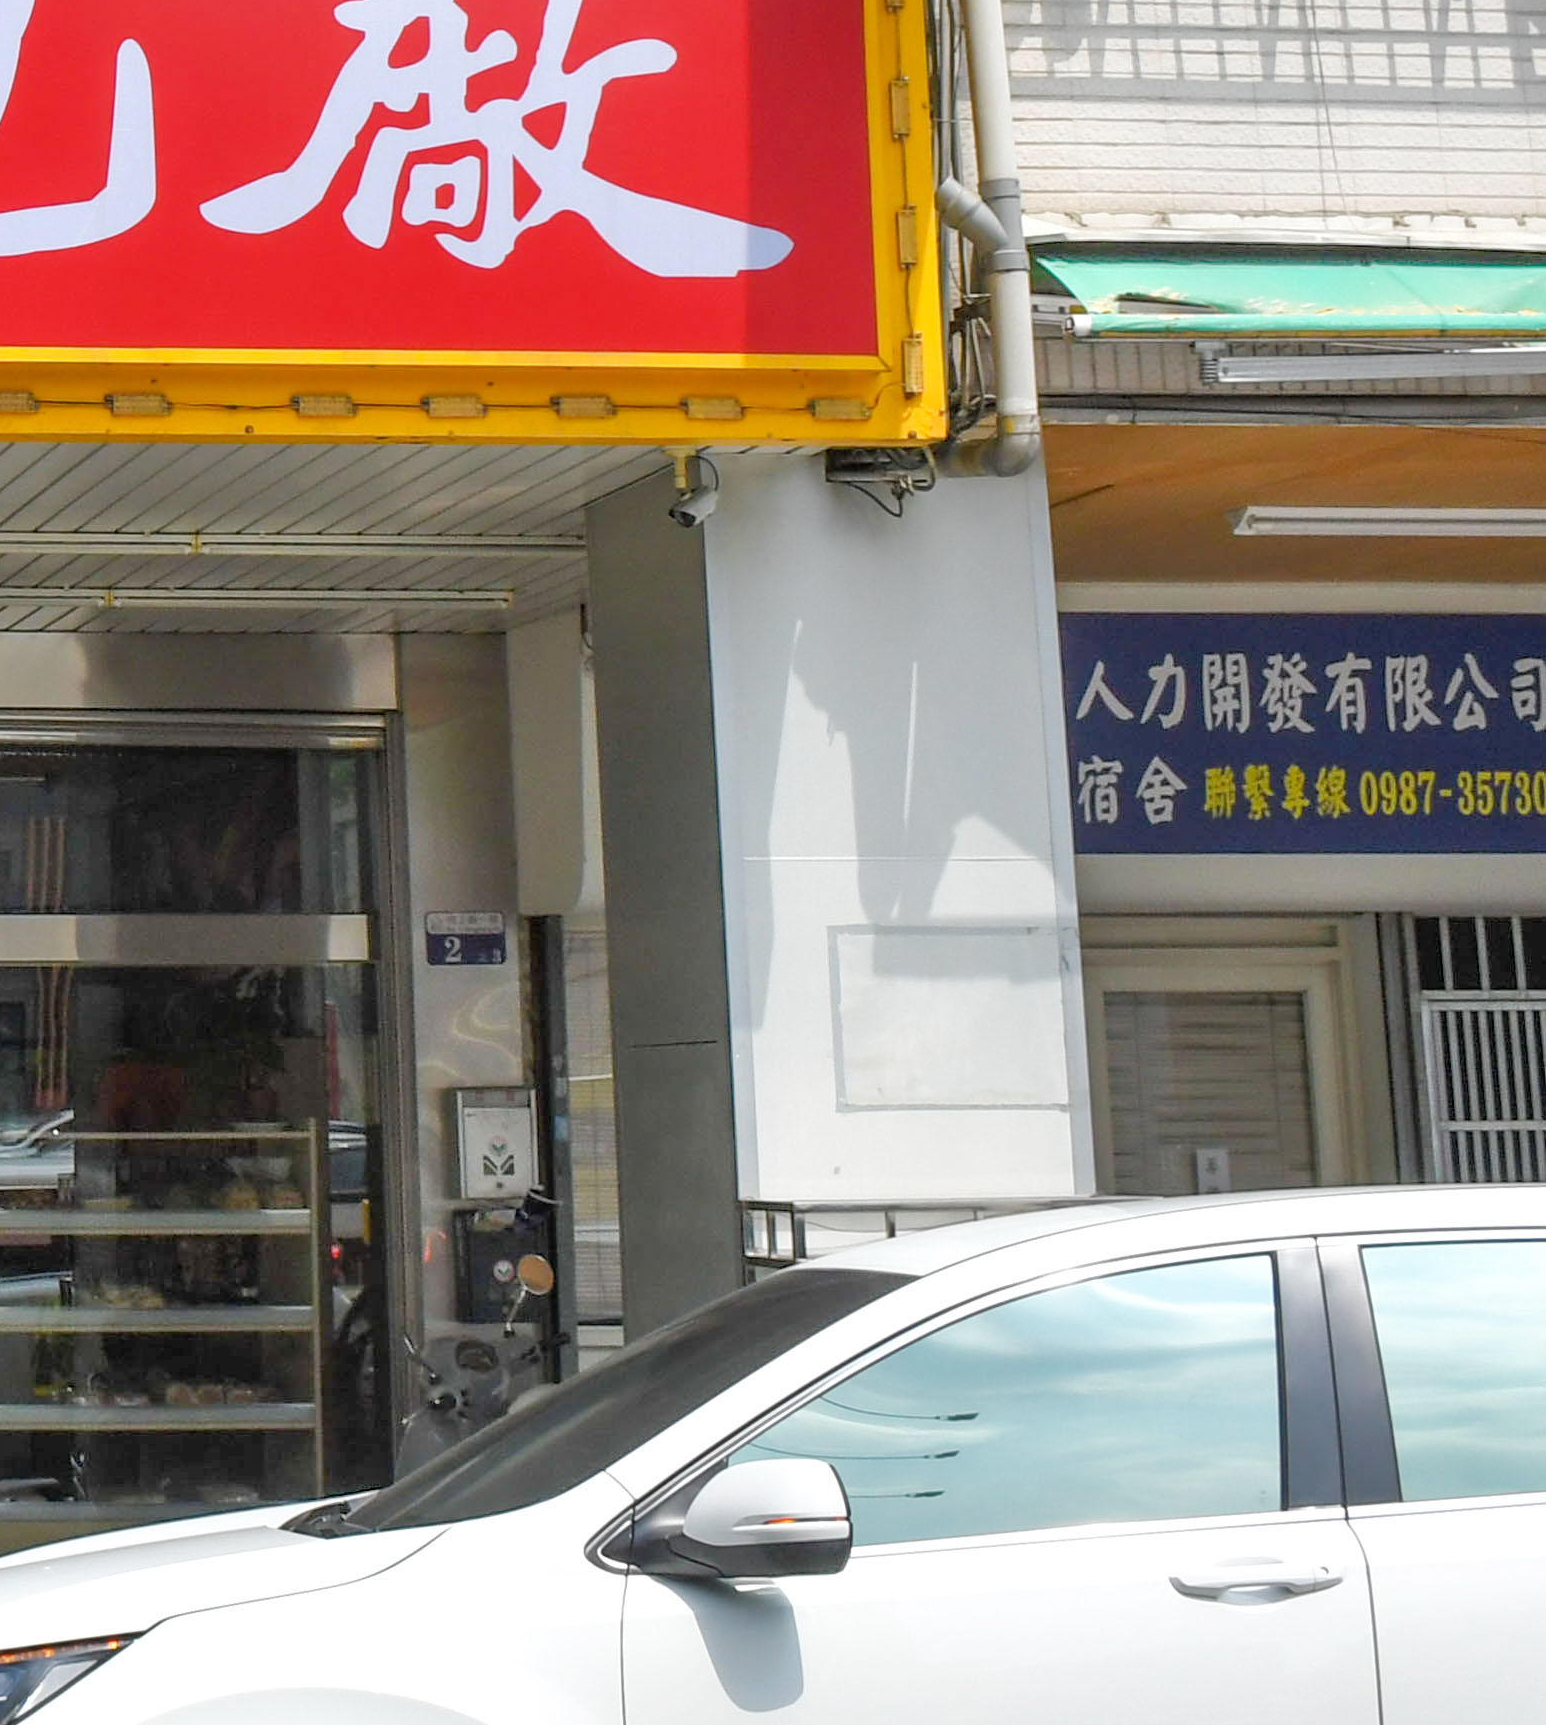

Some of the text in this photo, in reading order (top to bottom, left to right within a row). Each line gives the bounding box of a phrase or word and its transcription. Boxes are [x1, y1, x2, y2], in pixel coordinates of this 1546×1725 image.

[1076, 652, 1546, 734] 人力開發有限公司
[1076, 755, 1188, 824] 宿舍
